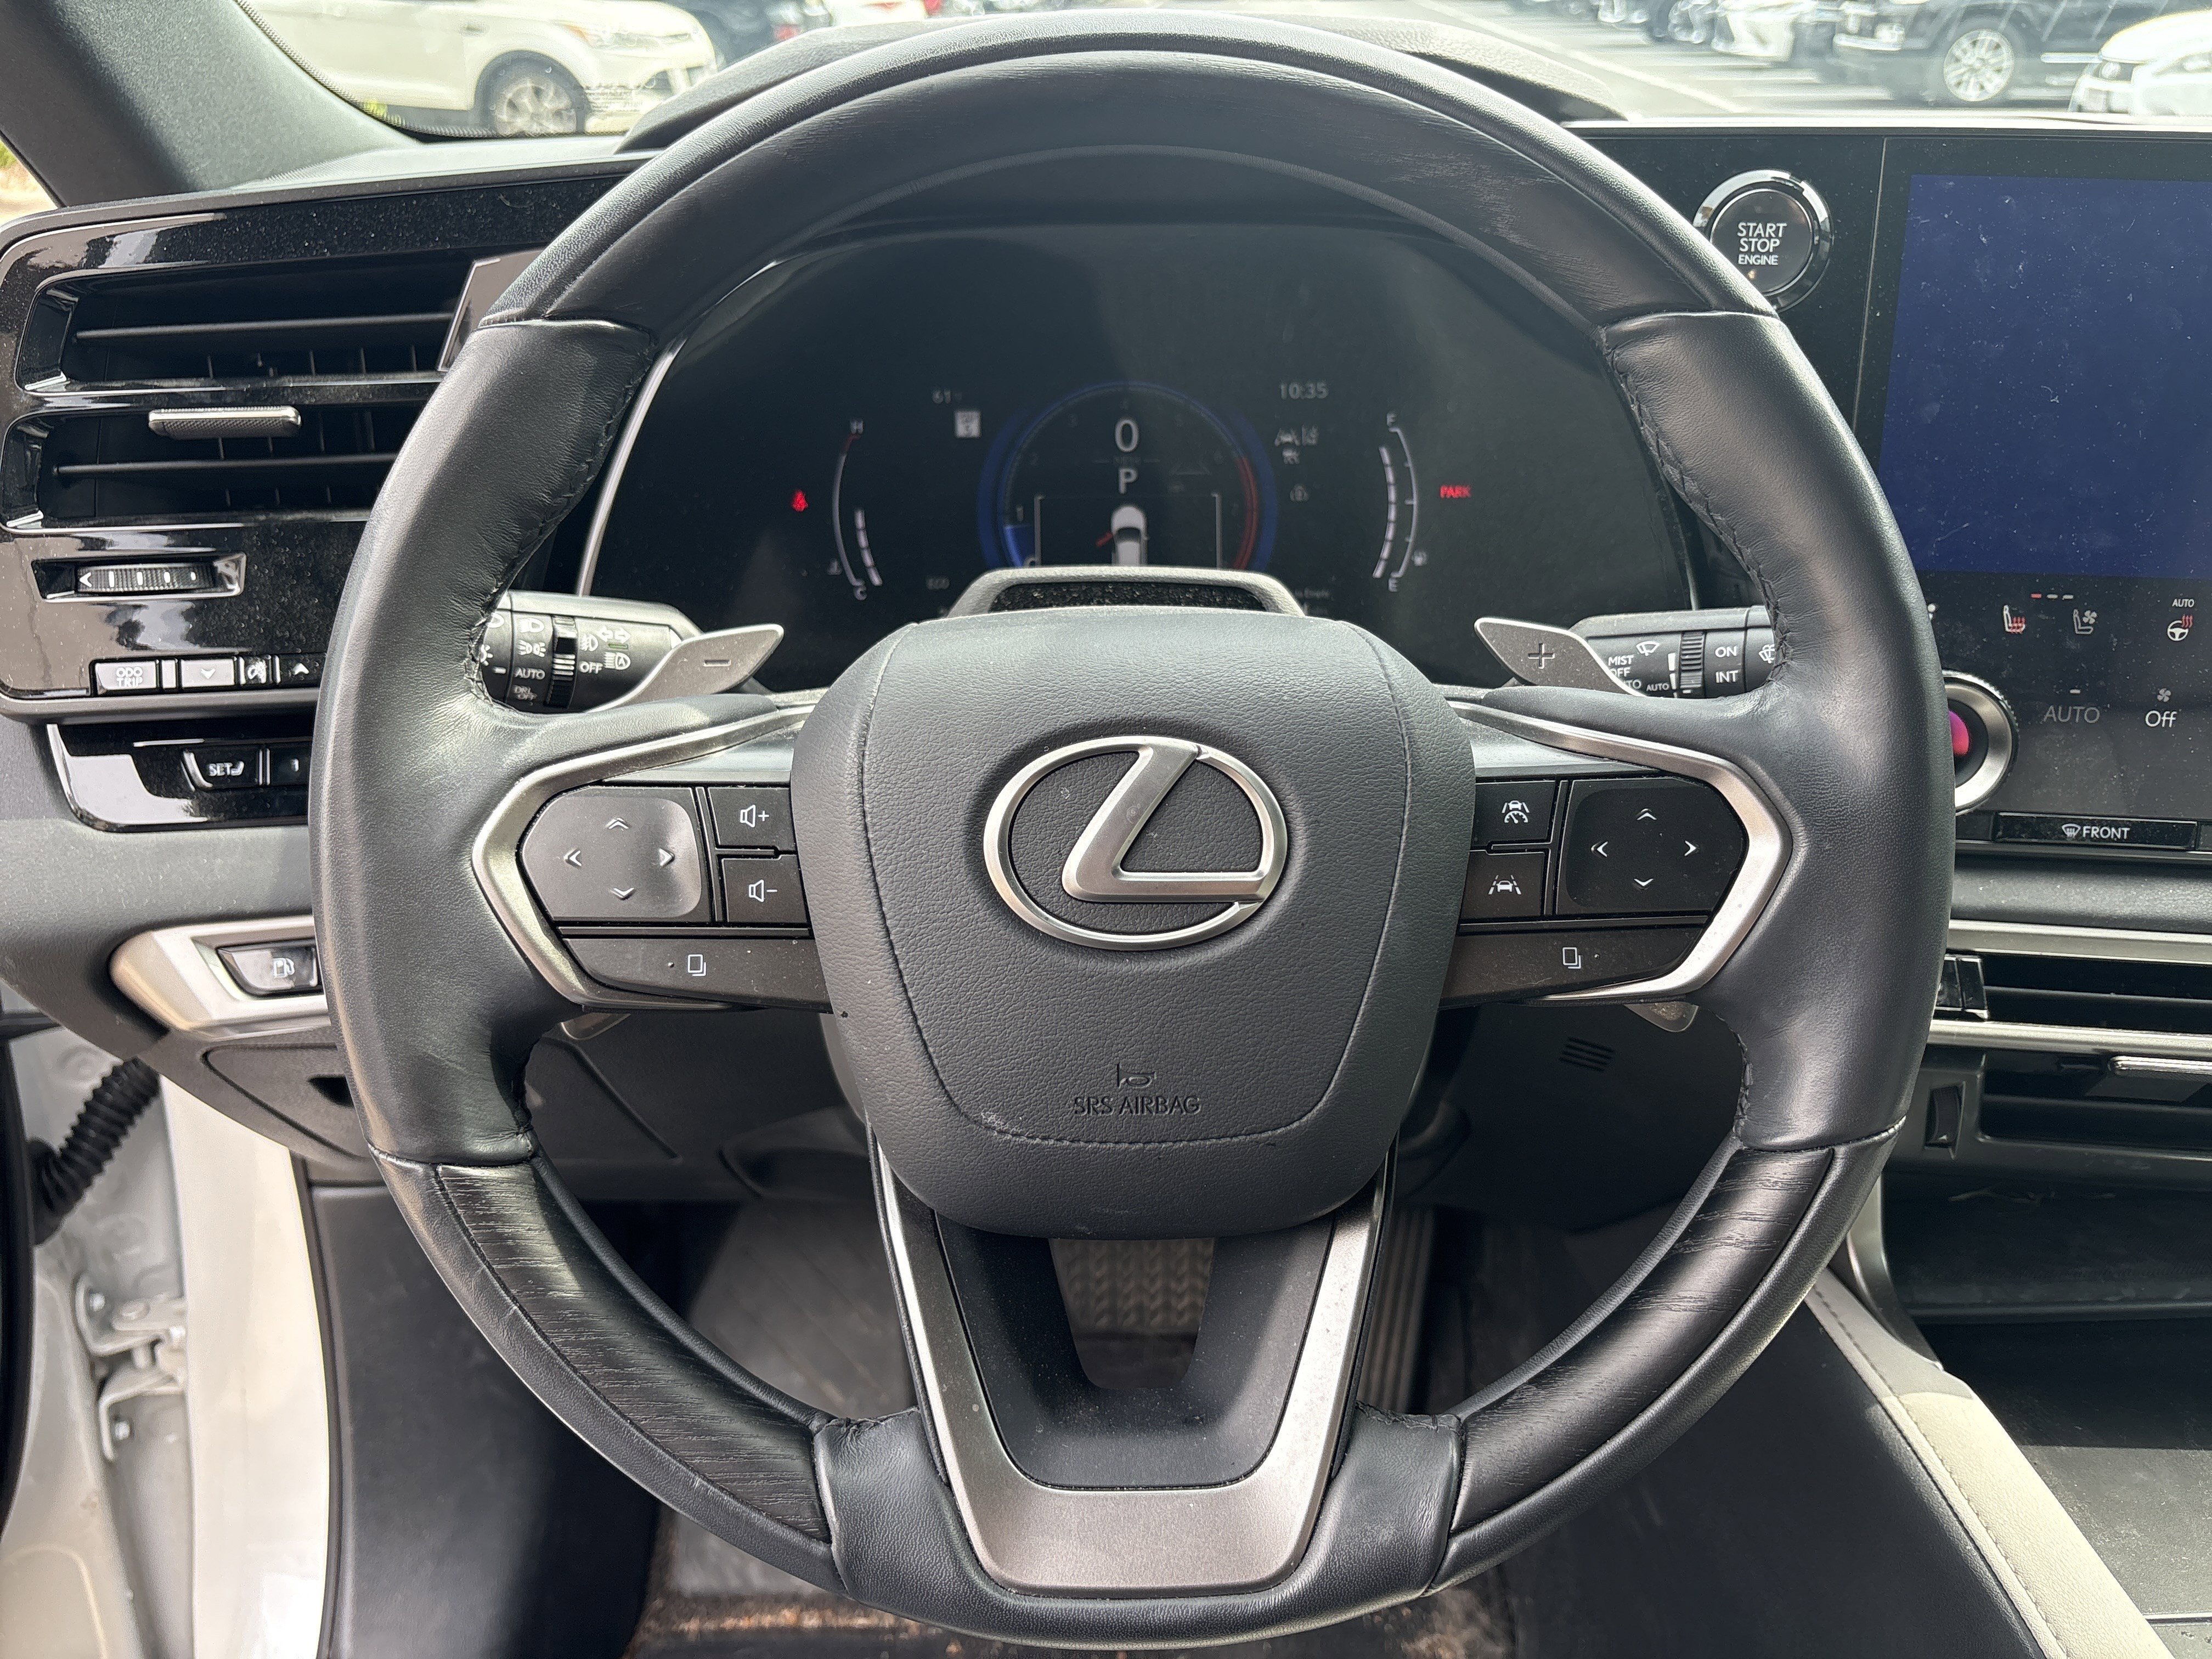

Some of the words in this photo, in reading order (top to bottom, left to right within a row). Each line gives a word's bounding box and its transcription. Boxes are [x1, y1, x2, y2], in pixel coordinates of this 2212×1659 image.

[1737, 222, 1787, 238] START
[1739, 238, 1781, 253] STOP
[1737, 254, 1779, 266] ENGINE
[1279, 383, 1329, 400] 10:35
[1118, 467, 1137, 493] P
[1440, 485, 1471, 499] PARK
[2171, 599, 2195, 608] AUTO
[1715, 646, 1737, 658] ON
[579, 661, 603, 674] OFF
[1608, 654, 1634, 667] MIST
[116, 666, 143, 677] ODO
[515, 668, 546, 680] AUTO
[1715, 669, 1740, 684] INT
[117, 676, 143, 687] TRIP
[1646, 682, 1669, 692] AUTO
[2043, 706, 2100, 724] AUTO
[2145, 710, 2177, 728] Off
[208, 762, 233, 776] SET
[291, 758, 300, 772] 1
[2083, 826, 2130, 840] FRONT
[1074, 1096, 1115, 1116] SRS
[1119, 1096, 1202, 1115] AIRBAG
